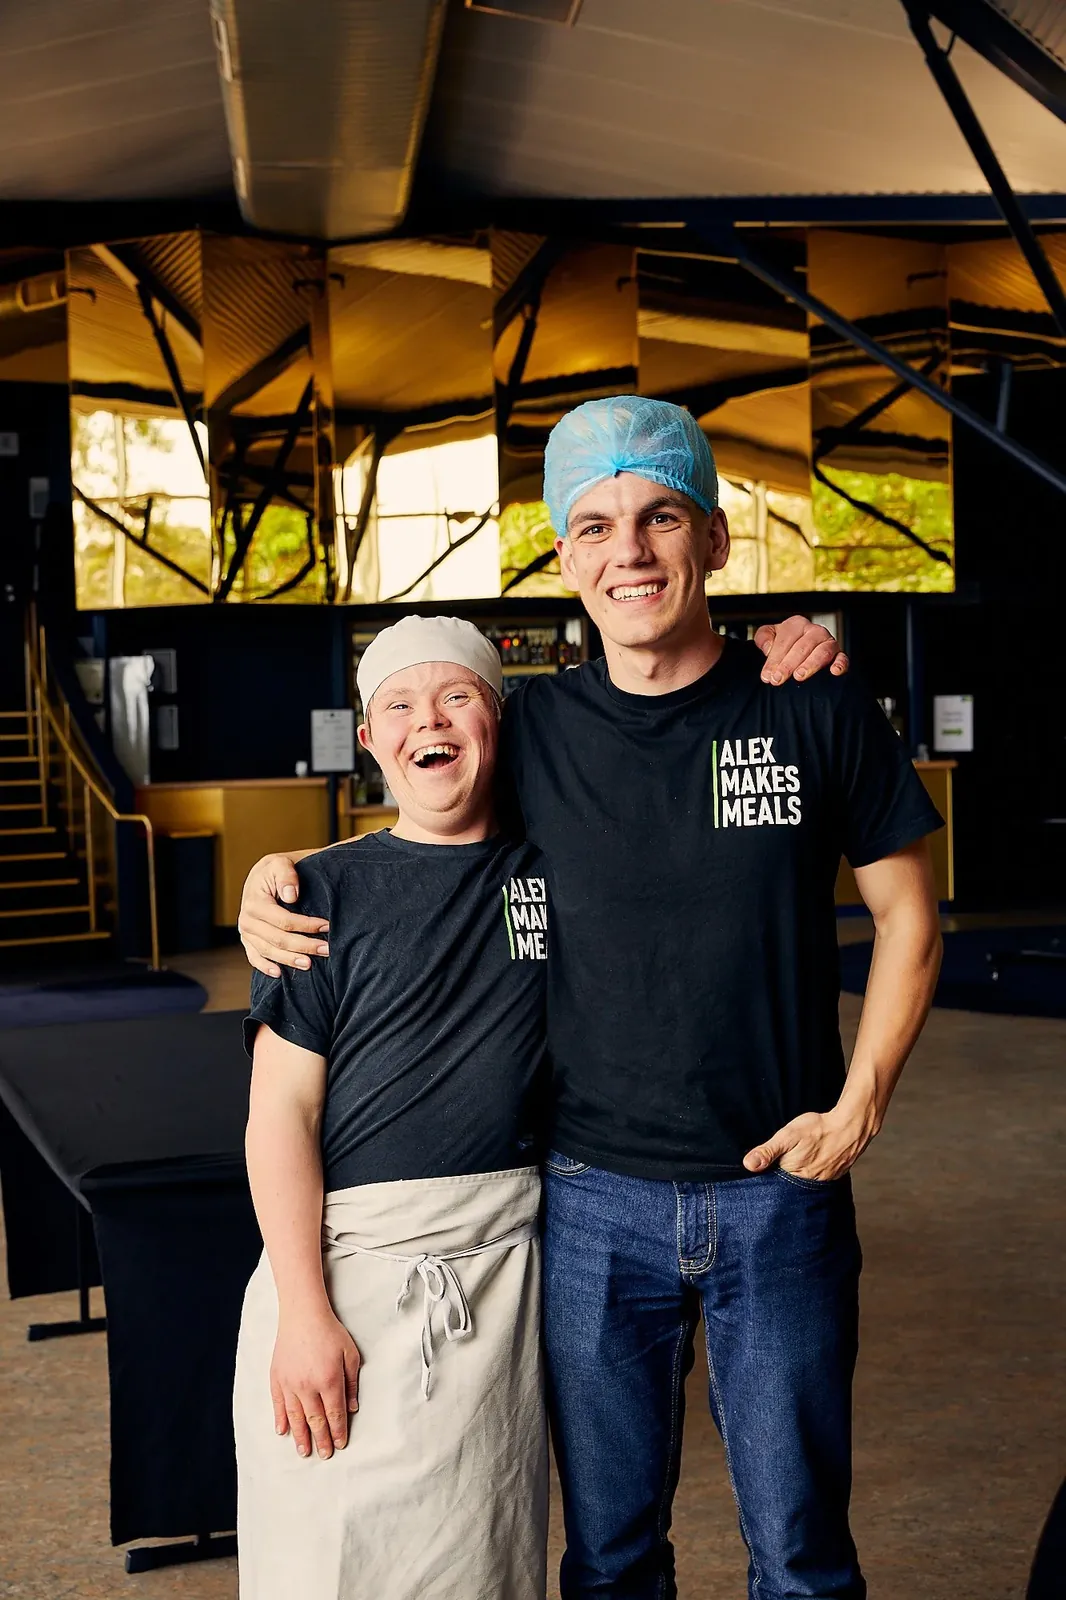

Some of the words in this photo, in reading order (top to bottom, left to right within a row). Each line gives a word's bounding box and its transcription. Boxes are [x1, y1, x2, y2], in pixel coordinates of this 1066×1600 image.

[720, 737, 776, 767] ALEX
[721, 765, 800, 797] MAKES
[722, 796, 802, 828] MEALS
[516, 932, 548, 960] ME
